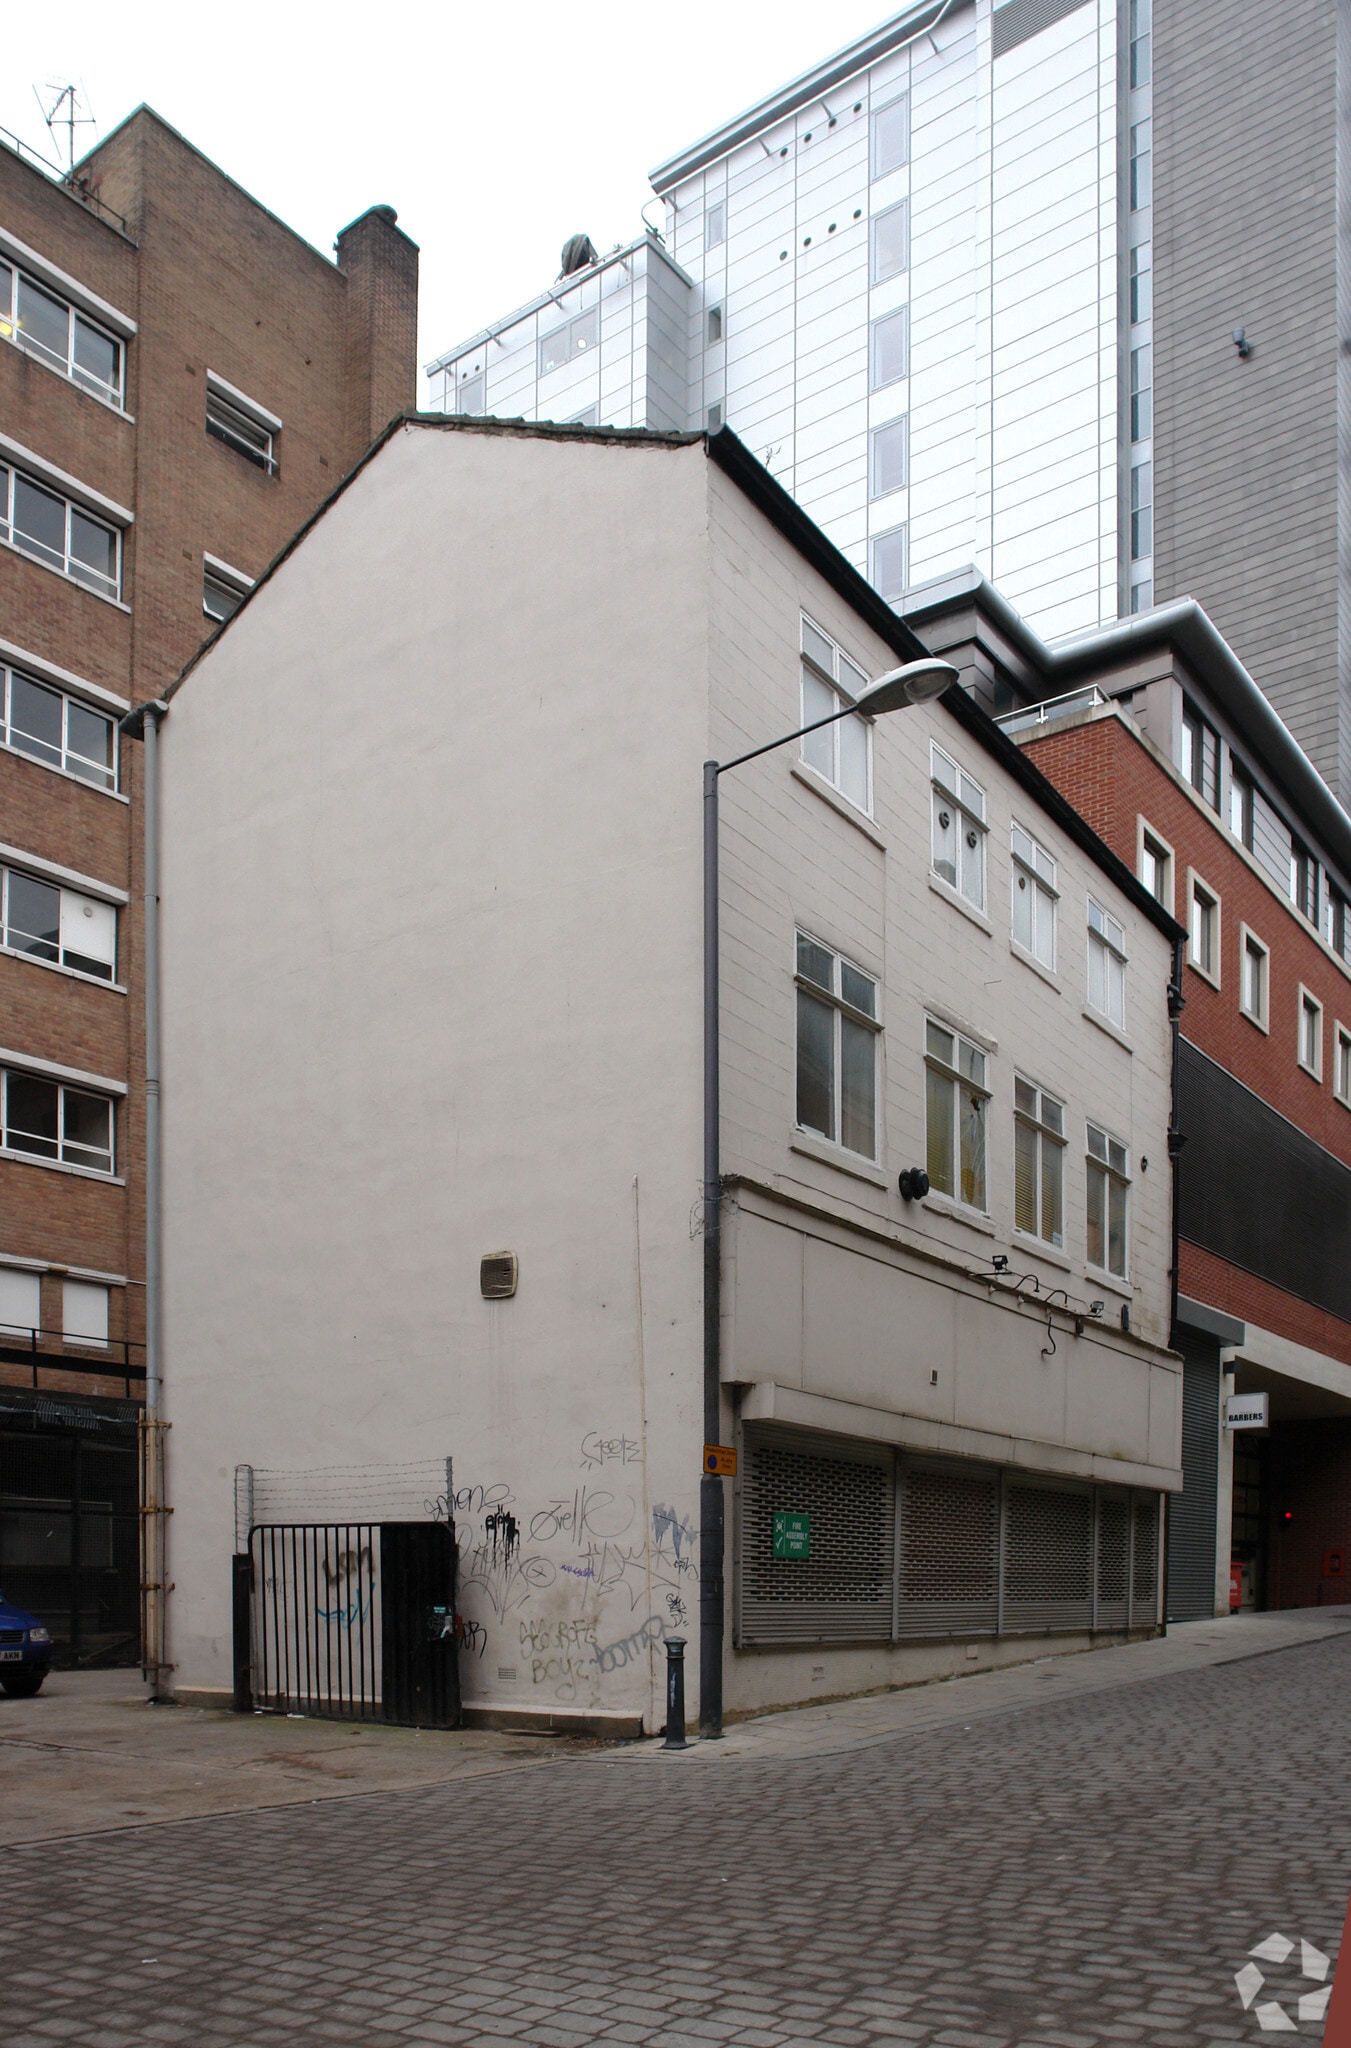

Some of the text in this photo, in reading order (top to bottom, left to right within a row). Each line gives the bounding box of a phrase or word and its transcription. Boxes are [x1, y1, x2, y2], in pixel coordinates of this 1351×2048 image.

[1229, 1413, 1263, 1422] BARBERS
[792, 1522, 802, 1531] FIRE
[786, 1531, 808, 1540] ASSEMBLY
[790, 1541, 803, 1550] POINT
